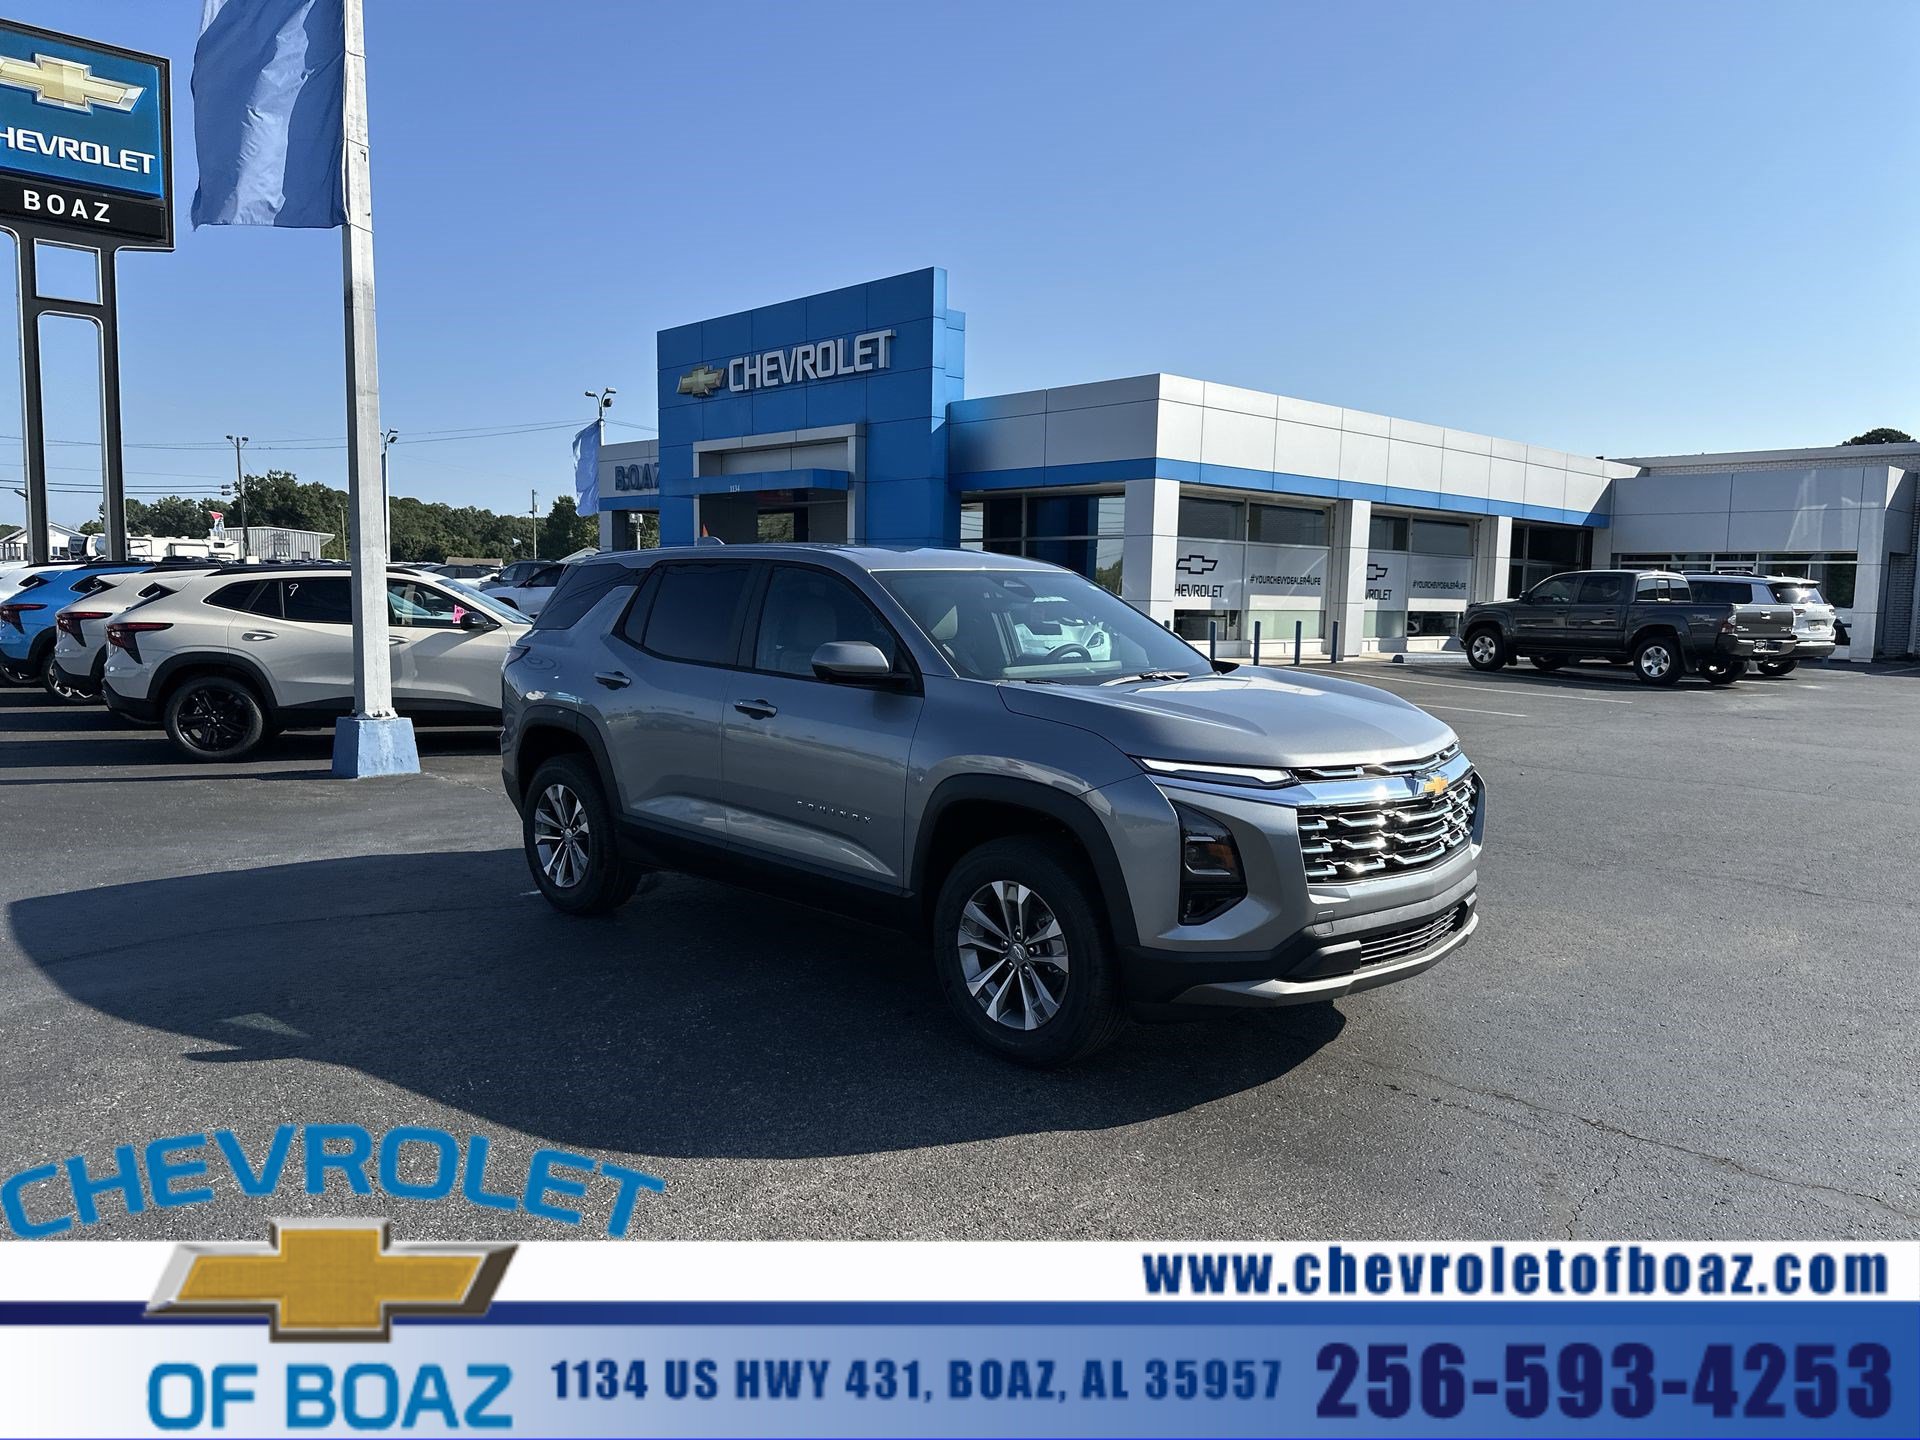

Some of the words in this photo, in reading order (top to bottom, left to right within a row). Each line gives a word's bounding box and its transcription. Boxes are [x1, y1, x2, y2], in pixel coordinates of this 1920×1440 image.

[0, 126, 155, 174] HEVROLET
[23, 189, 110, 223] BOAZ
[728, 329, 896, 393] CHEVROLET
[1174, 583, 1224, 598] HEVROLET
